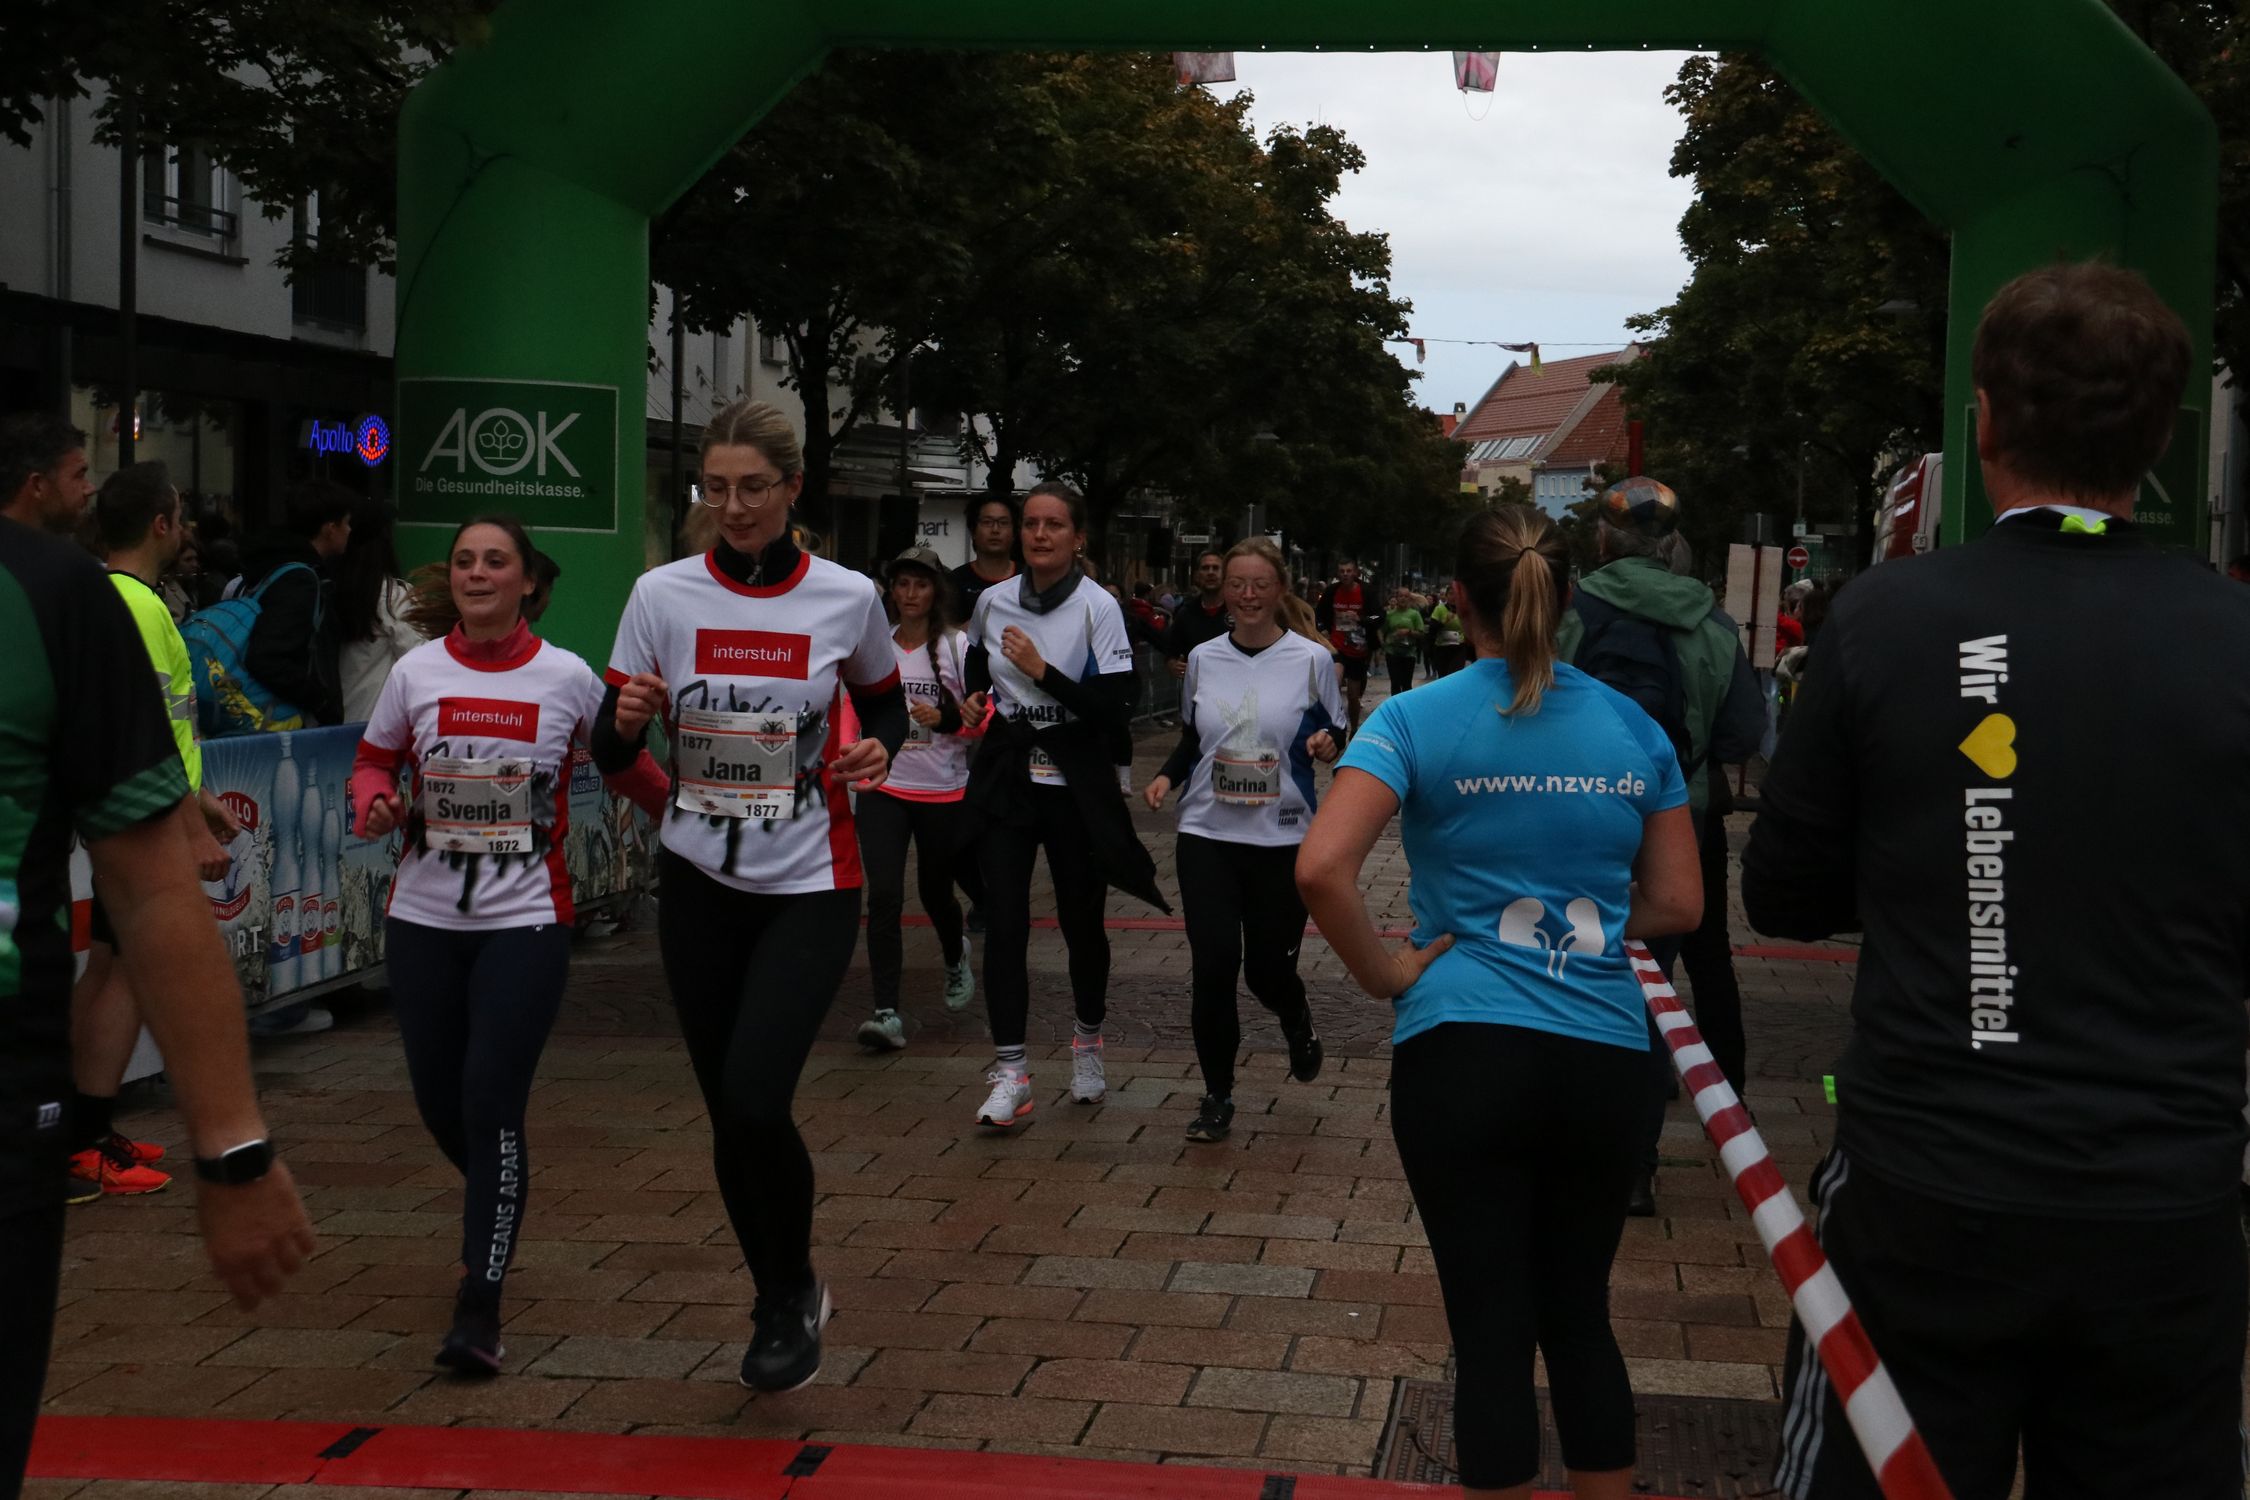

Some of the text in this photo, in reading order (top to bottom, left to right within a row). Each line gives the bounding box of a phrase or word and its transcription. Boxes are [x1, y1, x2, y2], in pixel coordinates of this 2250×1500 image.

[309, 419, 354, 459] Apollo
[419, 408, 582, 478] AOK
[415, 477, 585, 498] Die Gesundheitskasse.
[713, 643, 792, 662] interstuhl
[903, 682, 939, 696] ITZER
[451, 708, 523, 727] interstuhl
[681, 735, 713, 751] 1877
[702, 756, 762, 782] Jana
[426, 780, 455, 795] 1872
[1219, 775, 1267, 793] Carina
[1454, 771, 1646, 796] www.nzvs.de
[437, 798, 512, 824] Svenja
[745, 804, 779, 817] 1877
[488, 839, 519, 852] 1872
[1958, 634, 2019, 1050] Wir Lebensmittel.
[229, 925, 263, 957] RT
[486, 1128, 519, 1282] OCEANS APART
